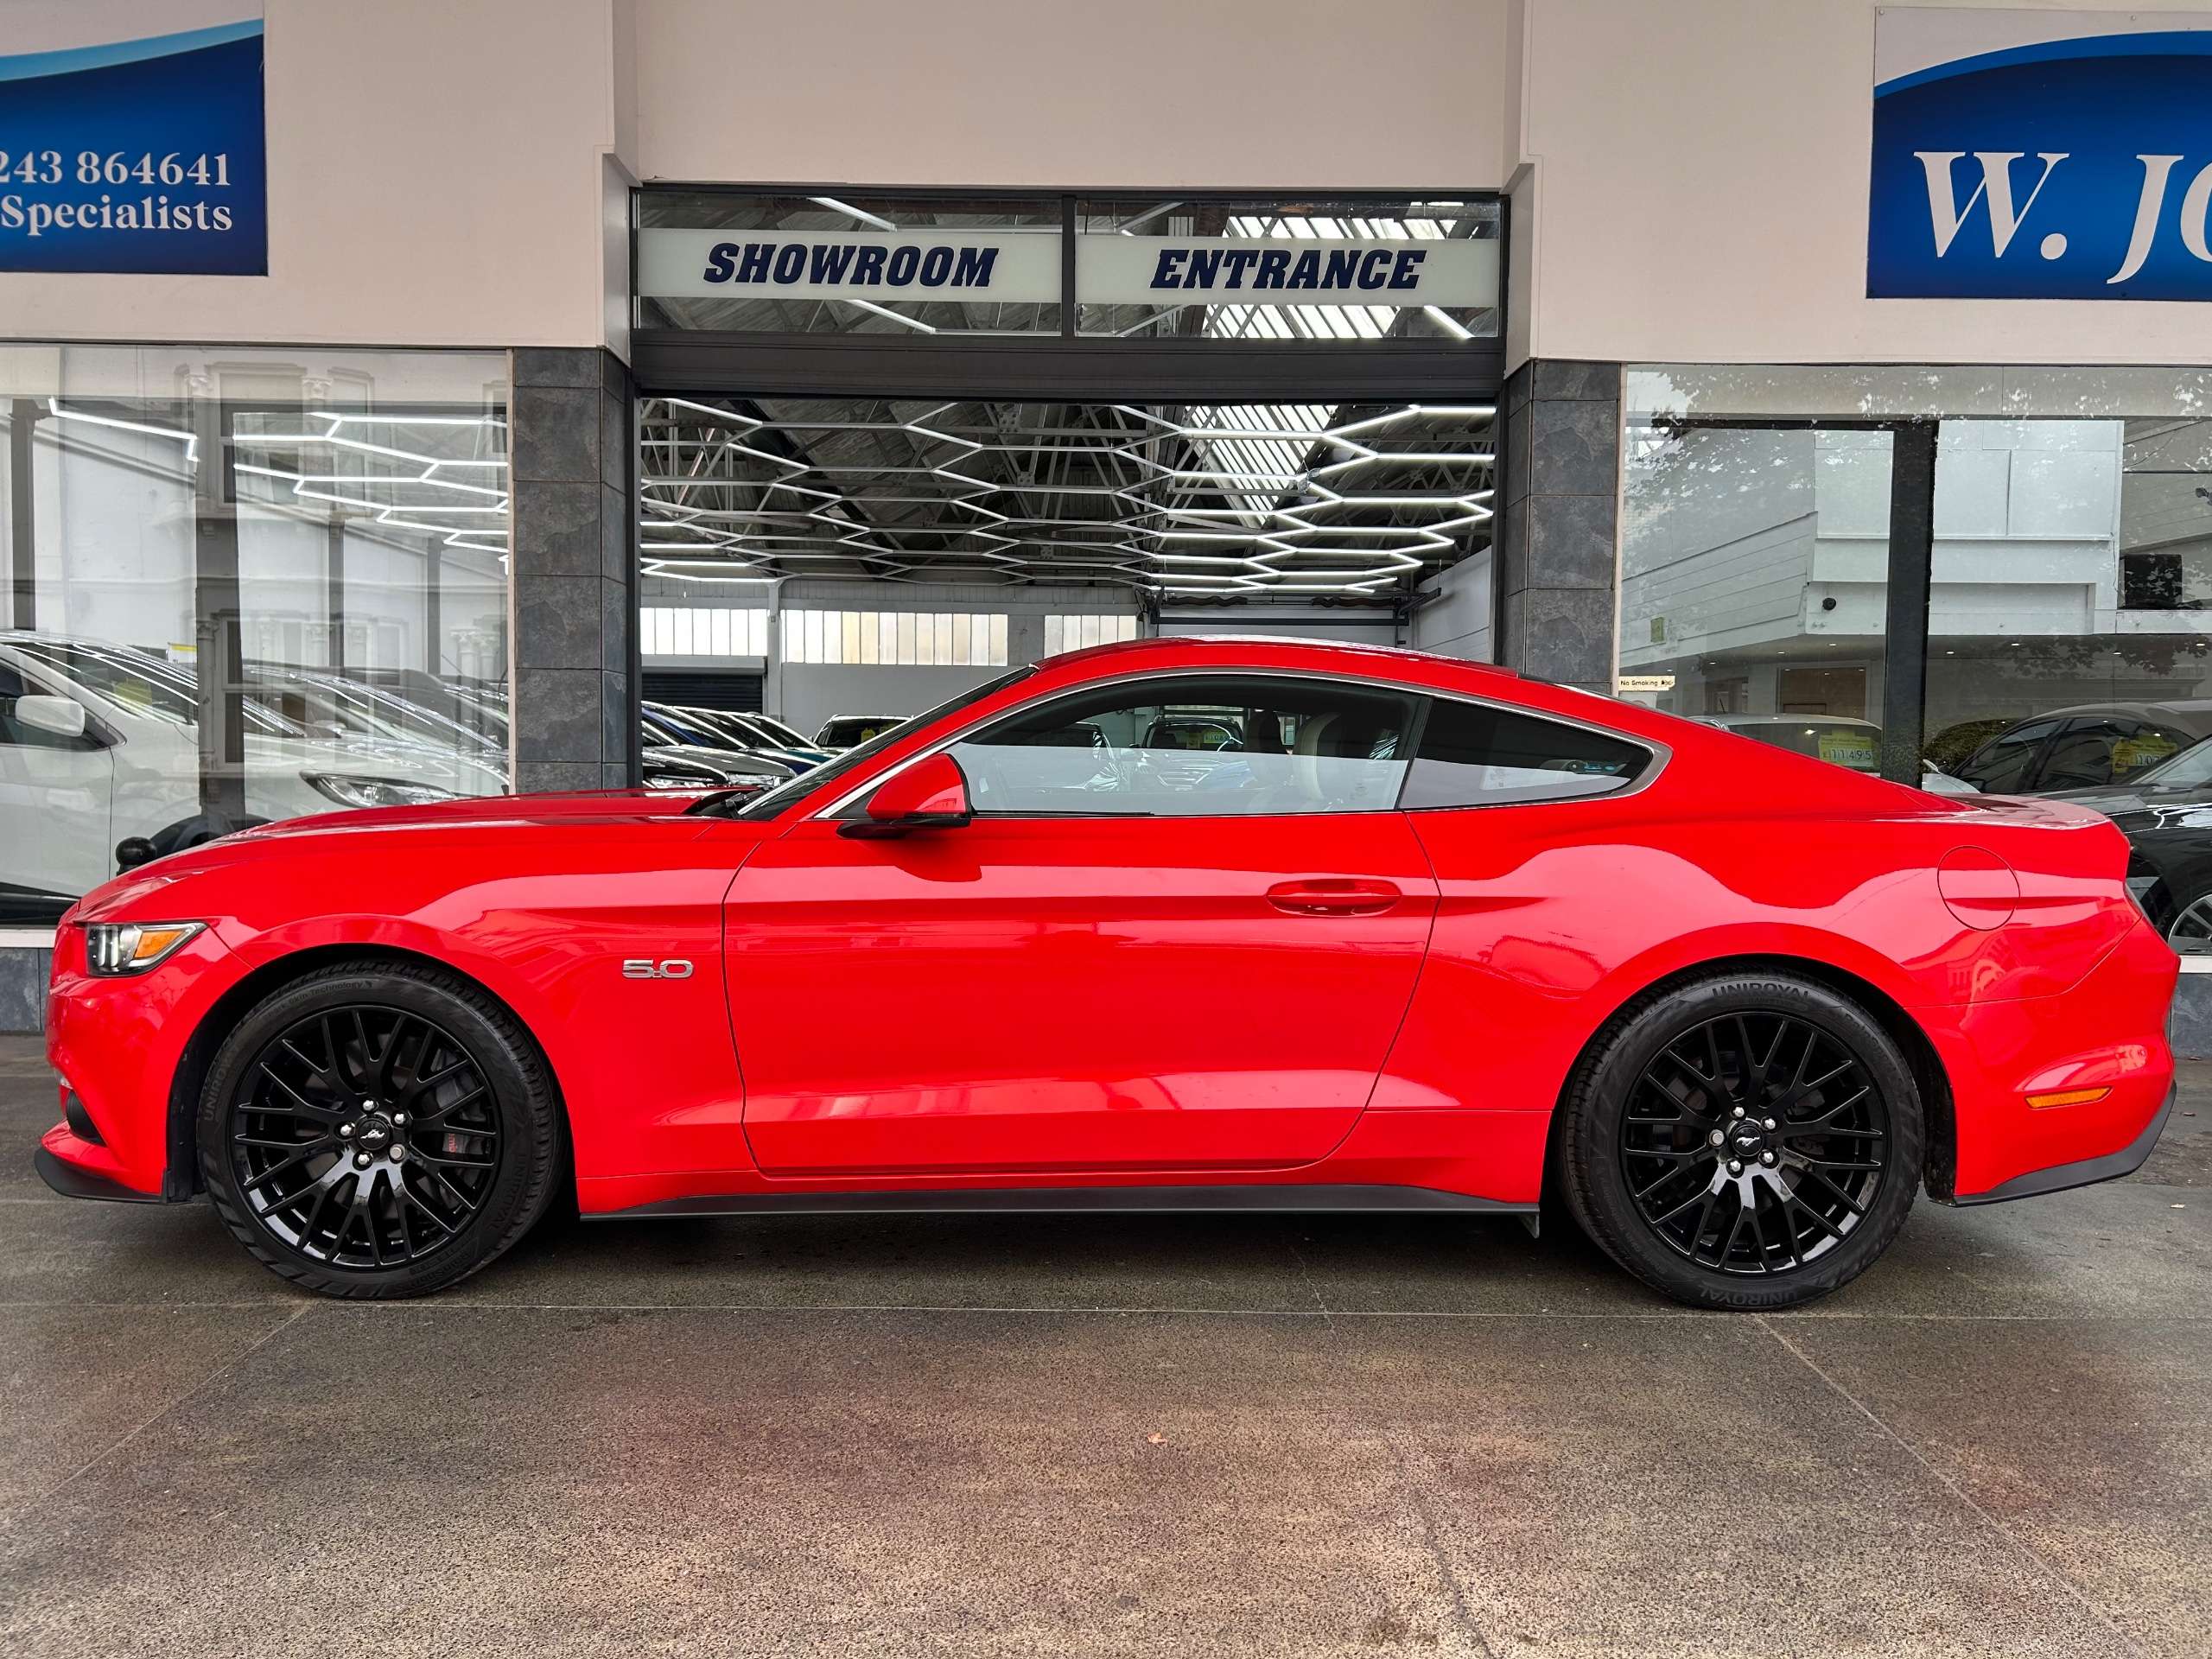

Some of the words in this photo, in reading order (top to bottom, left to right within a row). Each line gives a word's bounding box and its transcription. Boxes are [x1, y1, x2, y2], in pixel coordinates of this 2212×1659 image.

[76, 150, 231, 186] 864641
[1, 194, 232, 237] Specialists
[1913, 151, 2070, 260] W.
[702, 242, 1000, 288] SHOWROOM
[1149, 248, 1427, 290] ENTRANCE
[622, 958, 694, 979] 5.0
[1698, 1285, 1799, 1306] UNIROYAL
